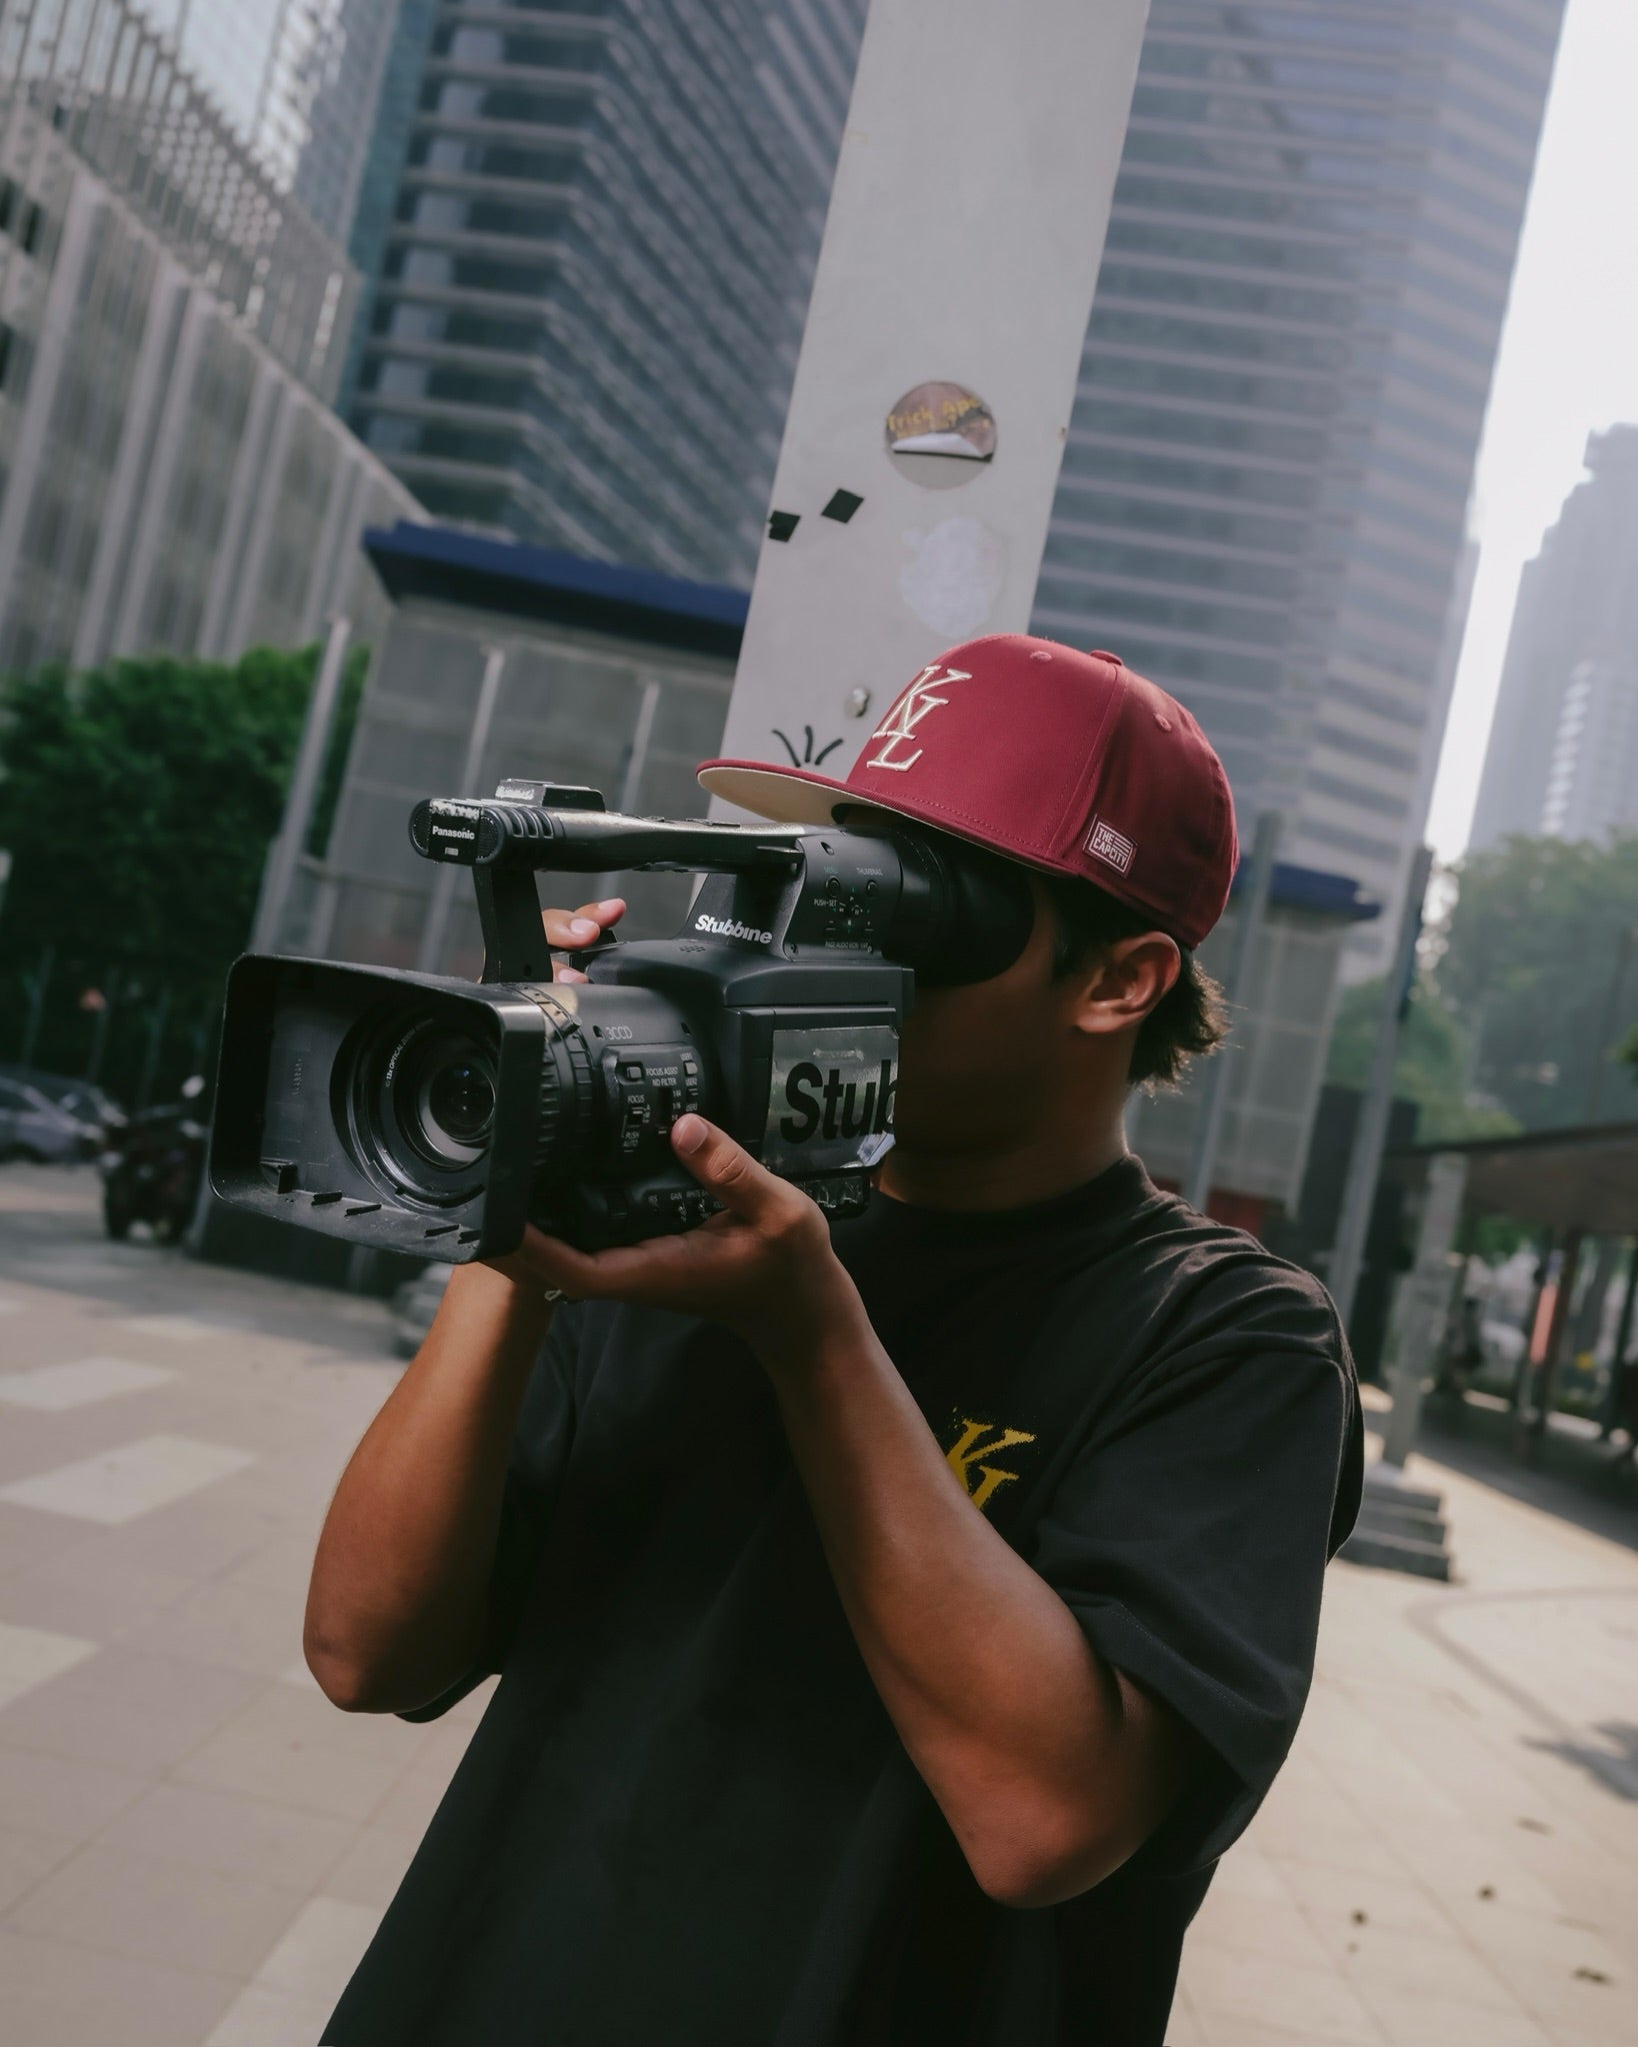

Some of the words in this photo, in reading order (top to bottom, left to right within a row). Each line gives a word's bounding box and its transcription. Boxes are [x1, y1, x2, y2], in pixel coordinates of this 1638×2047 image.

[432, 825, 475, 840] Panasonic
[1098, 827, 1115, 846] THE
[1093, 837, 1127, 867] CAPCITY
[695, 914, 773, 945] Stubbine
[606, 1025, 633, 1040] 3CCD
[646, 1066, 664, 1076] FOCUS
[661, 1077, 677, 1087] FILTER
[627, 1094, 645, 1104] FOCUS
